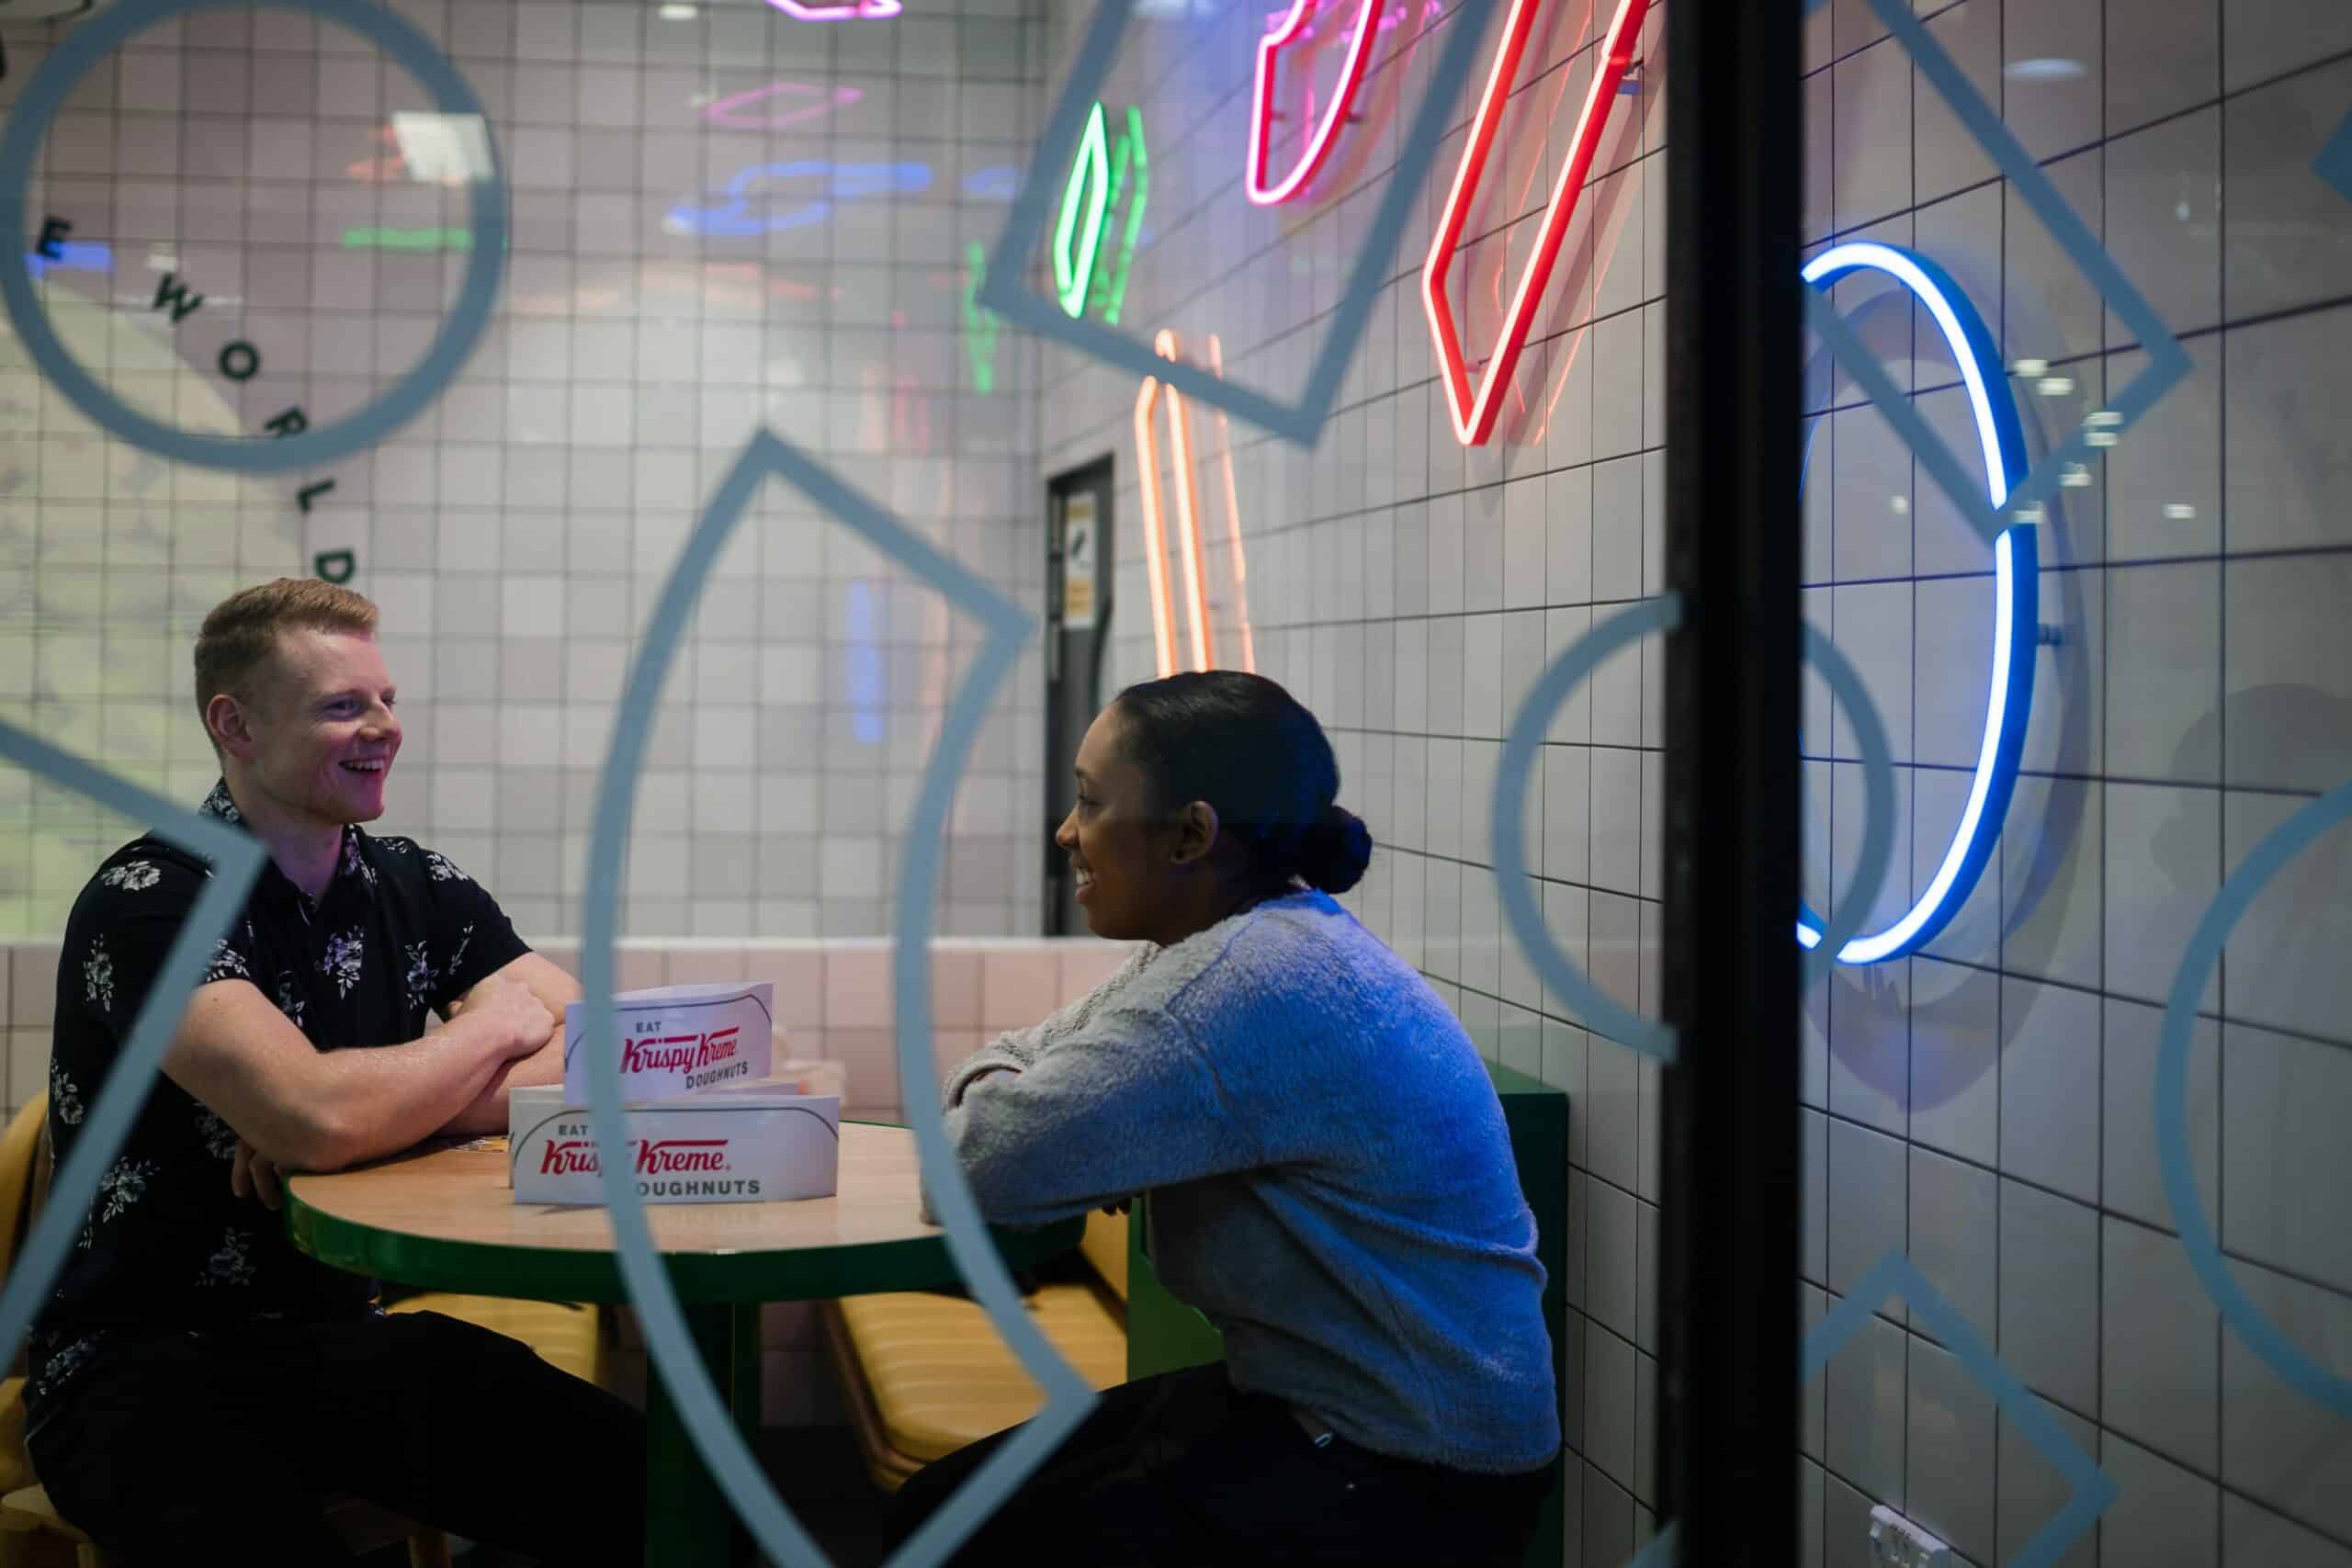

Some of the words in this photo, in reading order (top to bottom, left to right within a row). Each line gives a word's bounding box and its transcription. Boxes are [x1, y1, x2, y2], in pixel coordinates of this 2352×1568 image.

[152, 273, 356, 585] WORLD
[635, 1021, 662, 1033] EAT
[619, 1037, 698, 1074] Krispy
[695, 1026, 740, 1067] Kreme
[685, 1060, 749, 1089] DOUGHNUTS
[558, 1124, 590, 1137] EAT
[540, 1139, 632, 1178] Kris
[634, 1180, 761, 1196] OUGHNUTS
